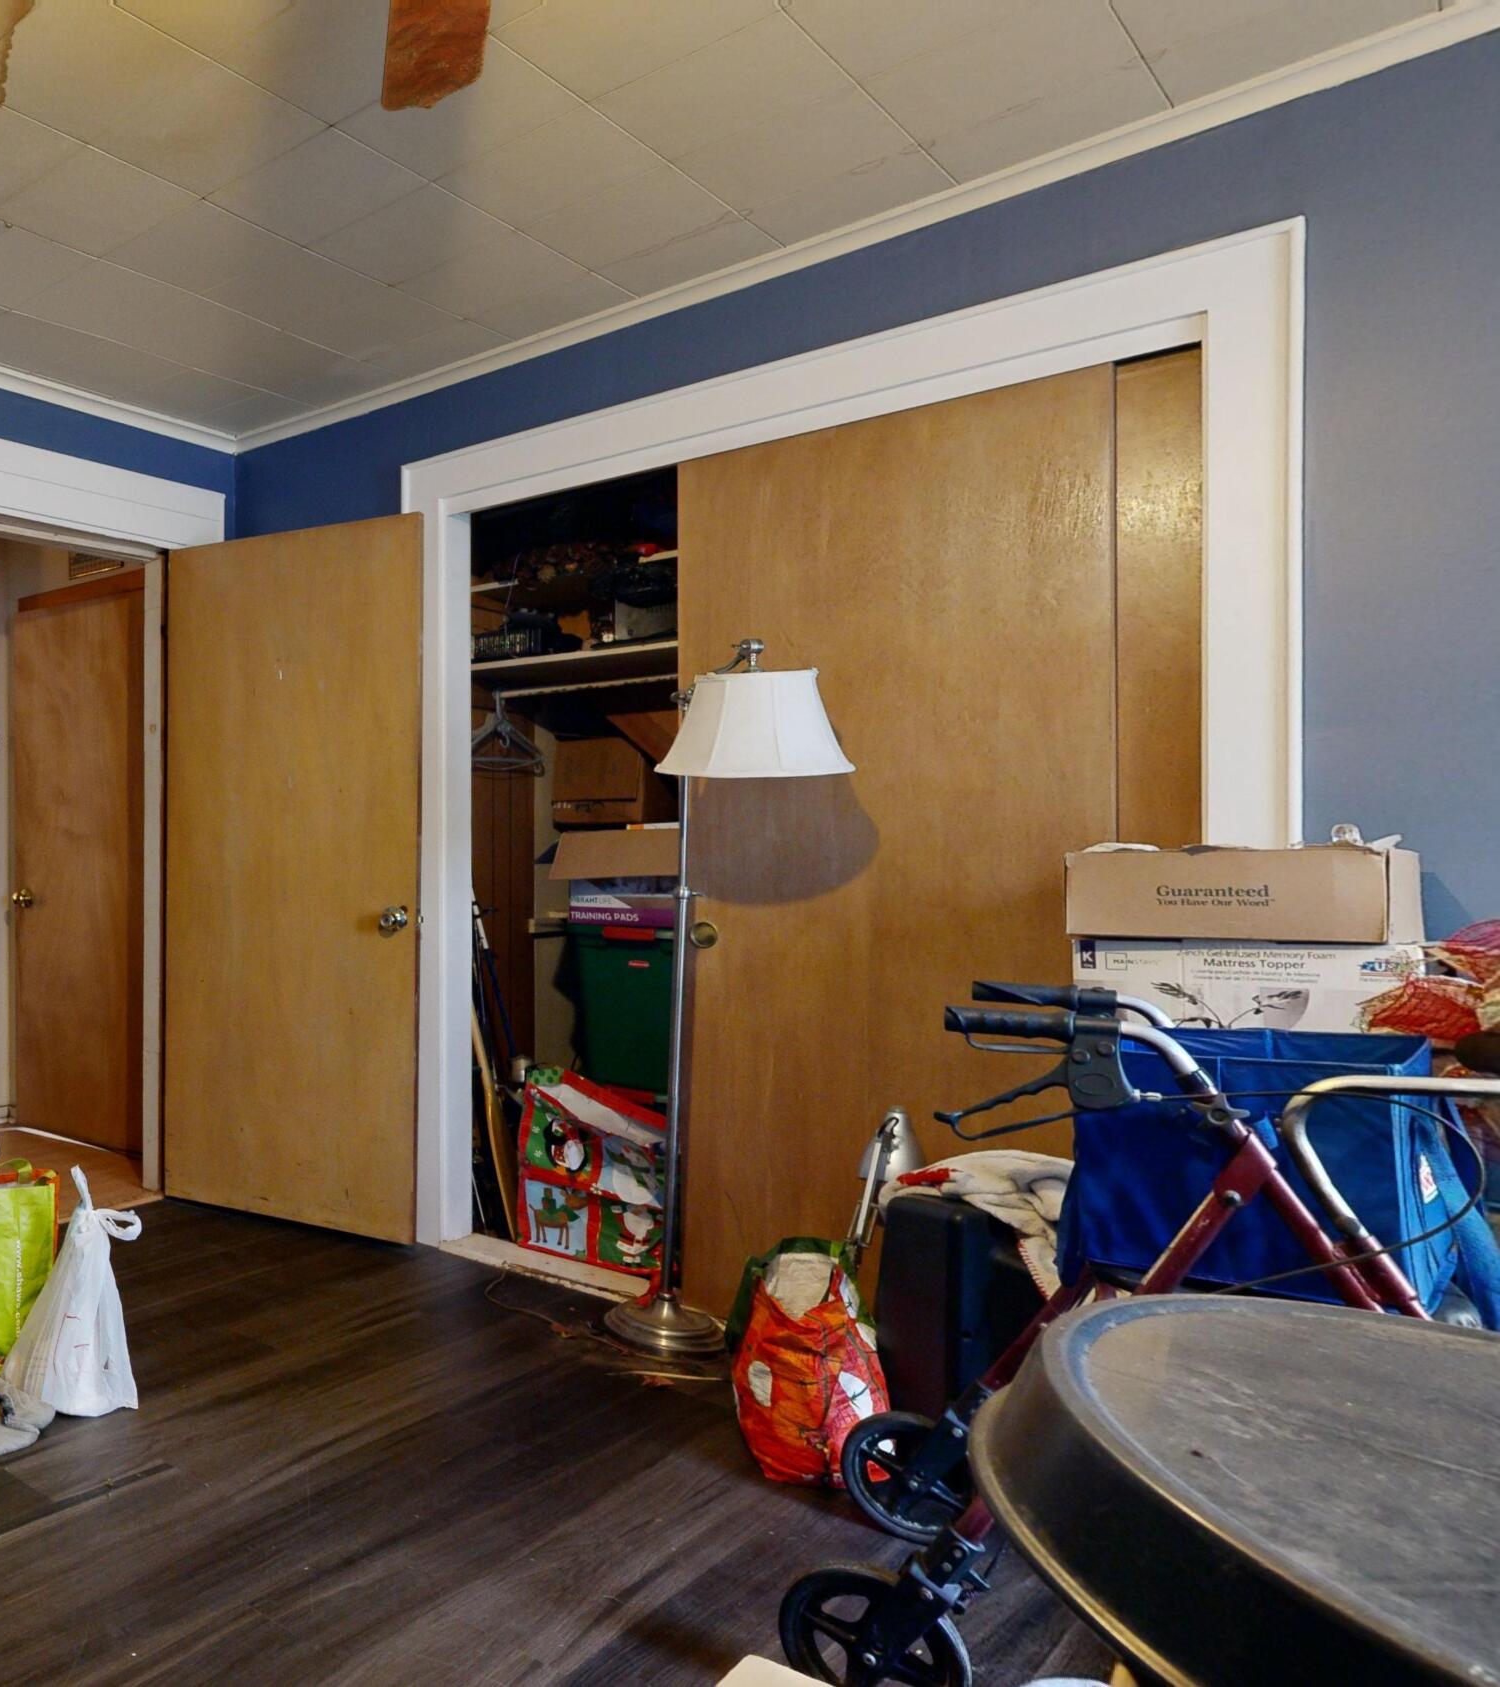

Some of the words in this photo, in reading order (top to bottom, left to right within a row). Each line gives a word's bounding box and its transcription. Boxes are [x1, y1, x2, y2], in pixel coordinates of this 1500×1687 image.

[1156, 884, 1269, 897] Guaranteed
[1156, 898, 1178, 906] You
[1181, 898, 1209, 906] Have
[1211, 899, 1233, 907] Our
[571, 911, 612, 921] TRAINING
[614, 912, 639, 922] PADS
[1082, 951, 1094, 963] K
[1263, 950, 1304, 961] Memory
[1307, 951, 1336, 960] Foam
[1203, 958, 1256, 969] Mattress
[1260, 959, 1307, 971] Topper
